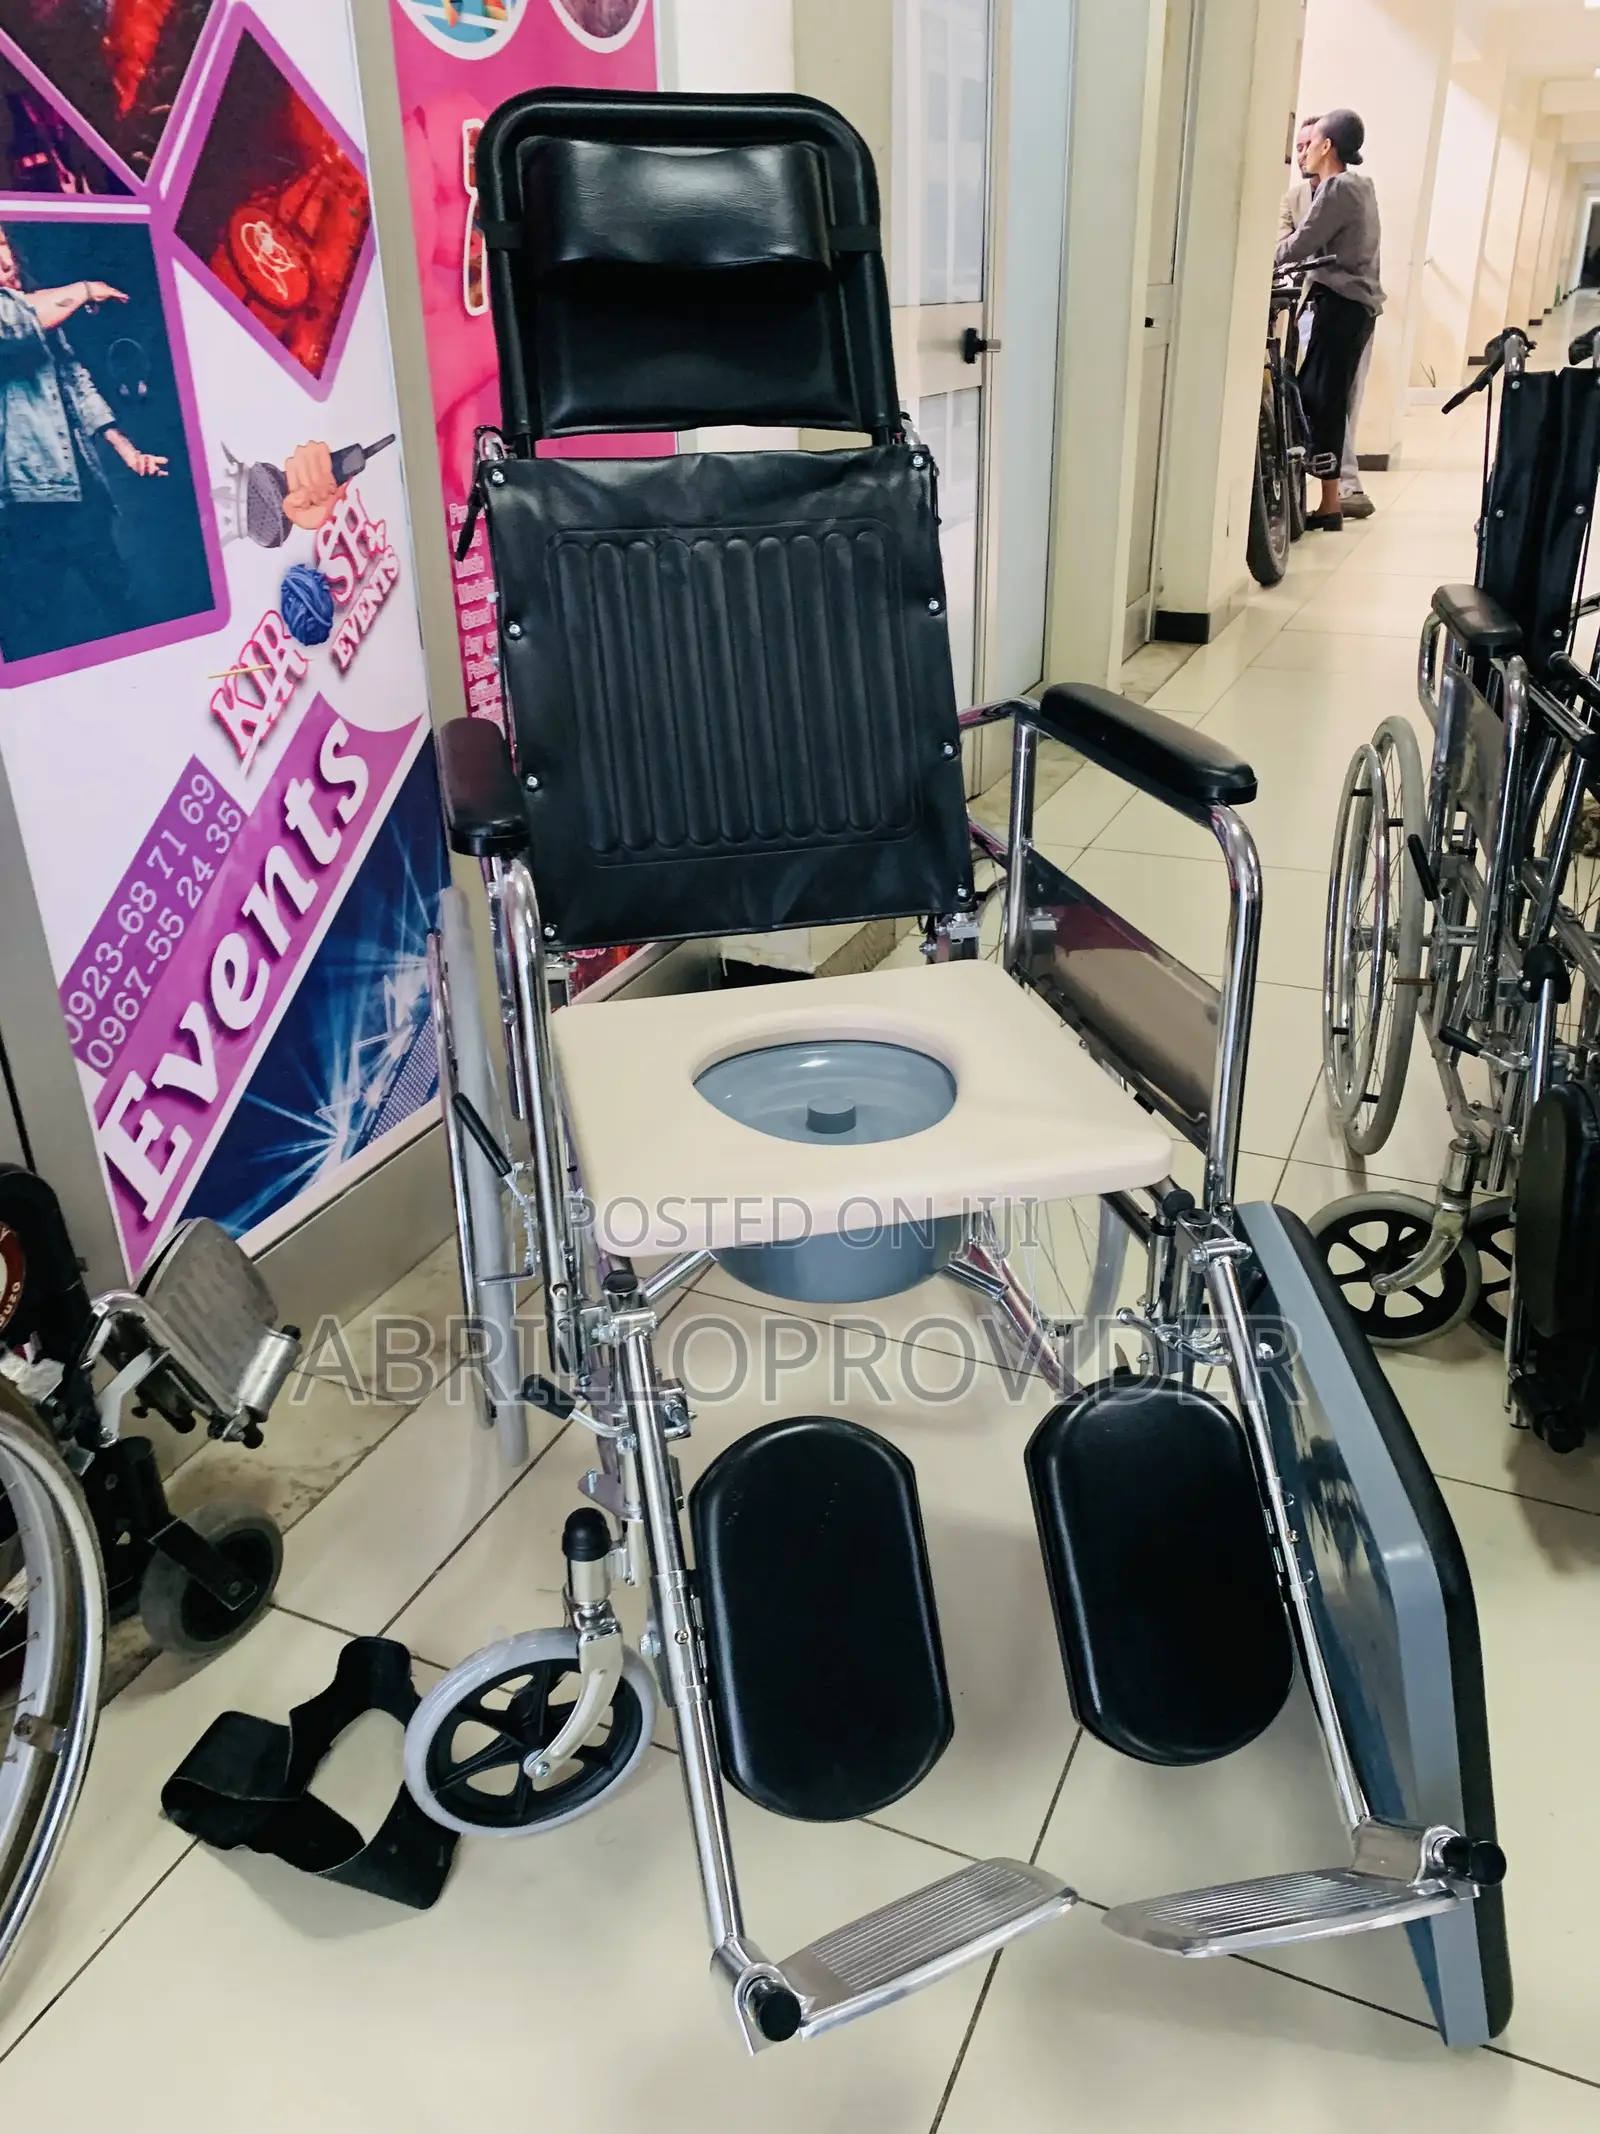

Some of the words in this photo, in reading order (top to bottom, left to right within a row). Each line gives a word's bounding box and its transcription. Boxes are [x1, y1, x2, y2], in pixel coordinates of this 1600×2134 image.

[332, 546, 399, 671] EVENTS
[146, 829, 187, 880] 71
[179, 774, 215, 825] 69
[87, 907, 185, 1069] 0967-55
[176, 855, 214, 909] 24
[206, 801, 242, 854] 35
[100, 716, 369, 1222] Events
